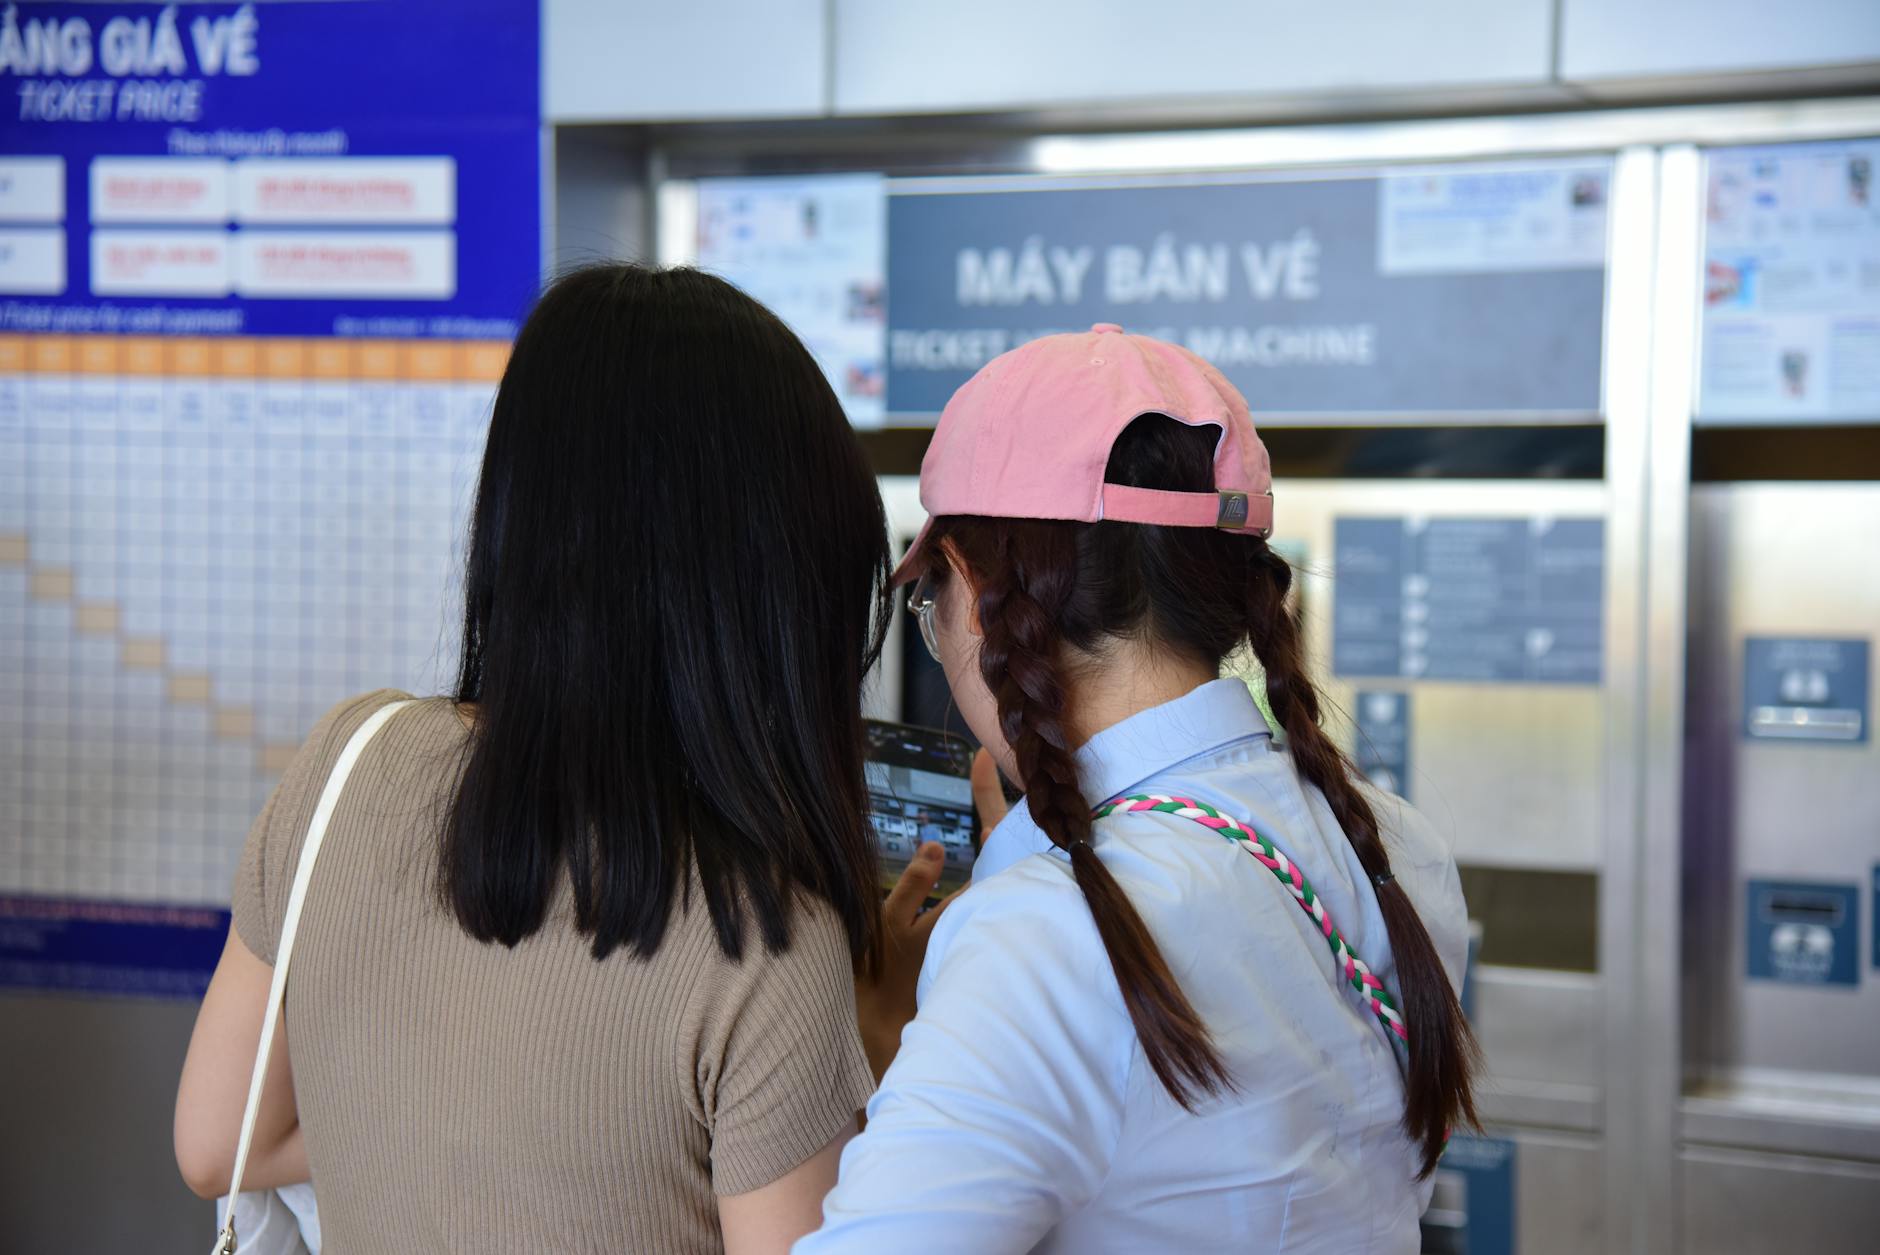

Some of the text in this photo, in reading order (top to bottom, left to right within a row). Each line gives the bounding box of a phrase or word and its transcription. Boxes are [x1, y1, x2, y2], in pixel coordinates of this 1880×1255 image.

[101, 3, 187, 76] GIÁ
[190, 3, 260, 76] VÉ
[18, 80, 205, 121] TICKET PRICE
[956, 234, 1093, 306] MÁY
[1105, 232, 1230, 303] BÁN
[1240, 228, 1321, 300] VÉ
[891, 328, 1007, 371] TICKET
[1183, 323, 1376, 366] MACHINE
